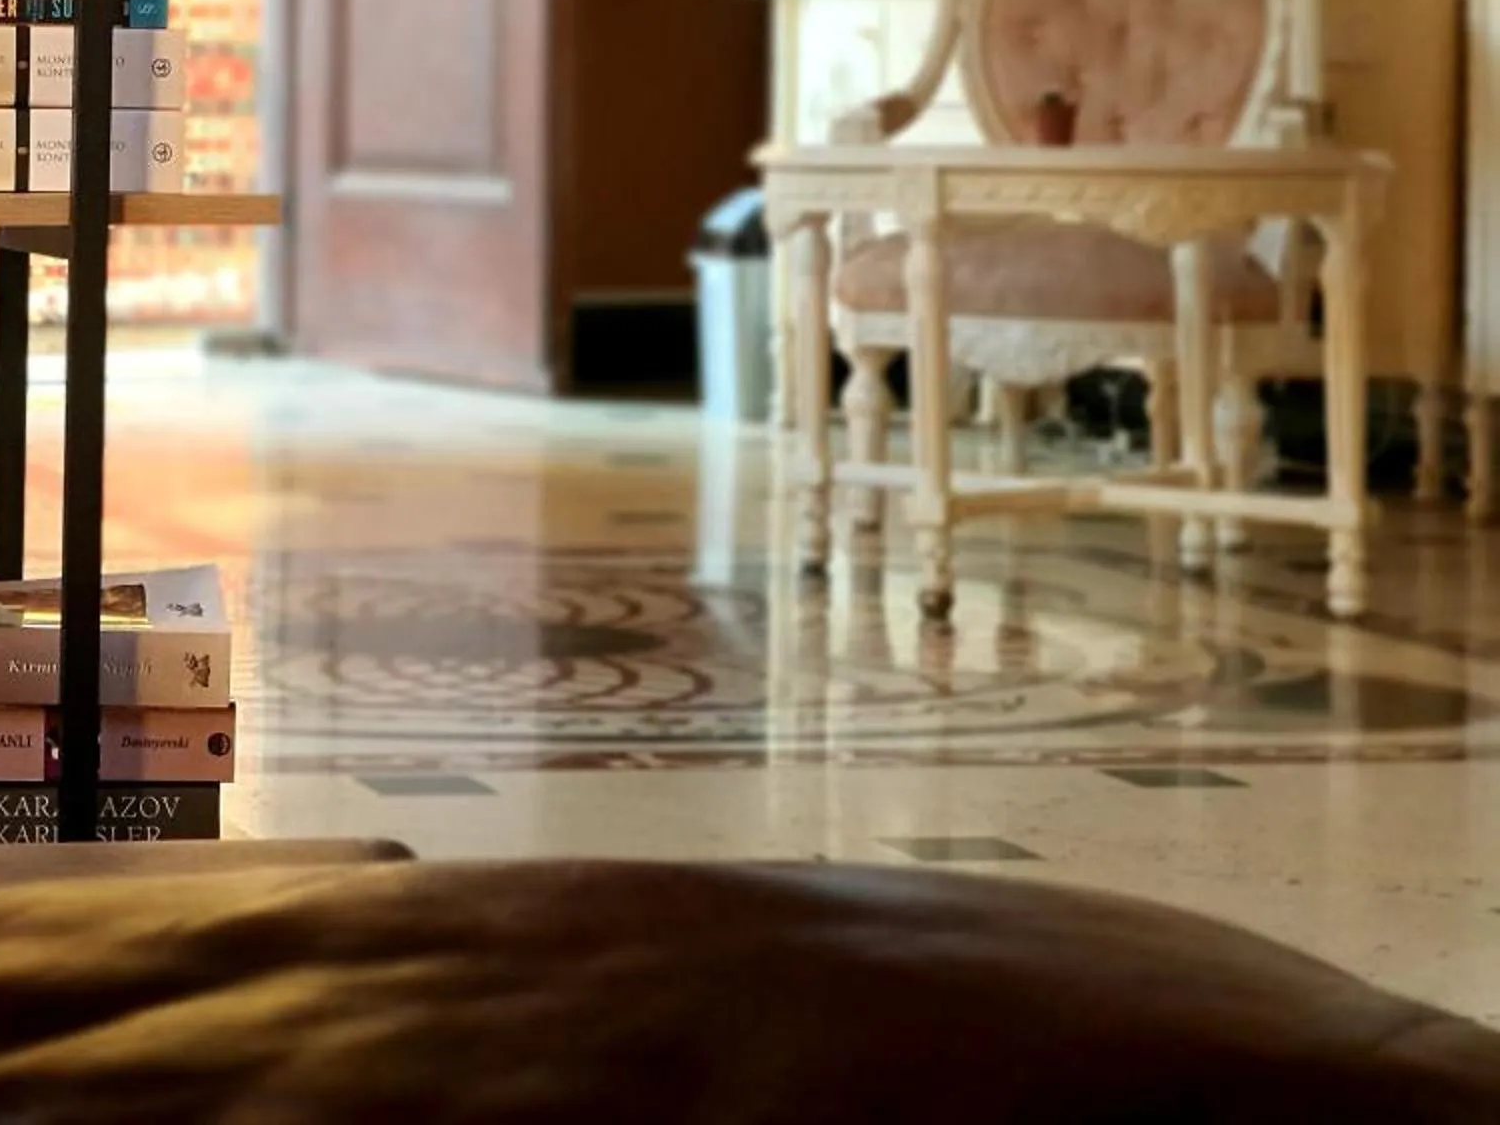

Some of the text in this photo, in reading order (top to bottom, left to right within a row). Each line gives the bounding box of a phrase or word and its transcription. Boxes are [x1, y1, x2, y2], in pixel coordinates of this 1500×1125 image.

[37, 56, 73, 64] MONT
[37, 68, 72, 77] KONT
[37, 140, 72, 150] MONT
[37, 153, 70, 163] KONT
[121, 735, 189, 750] Dostoyevski
